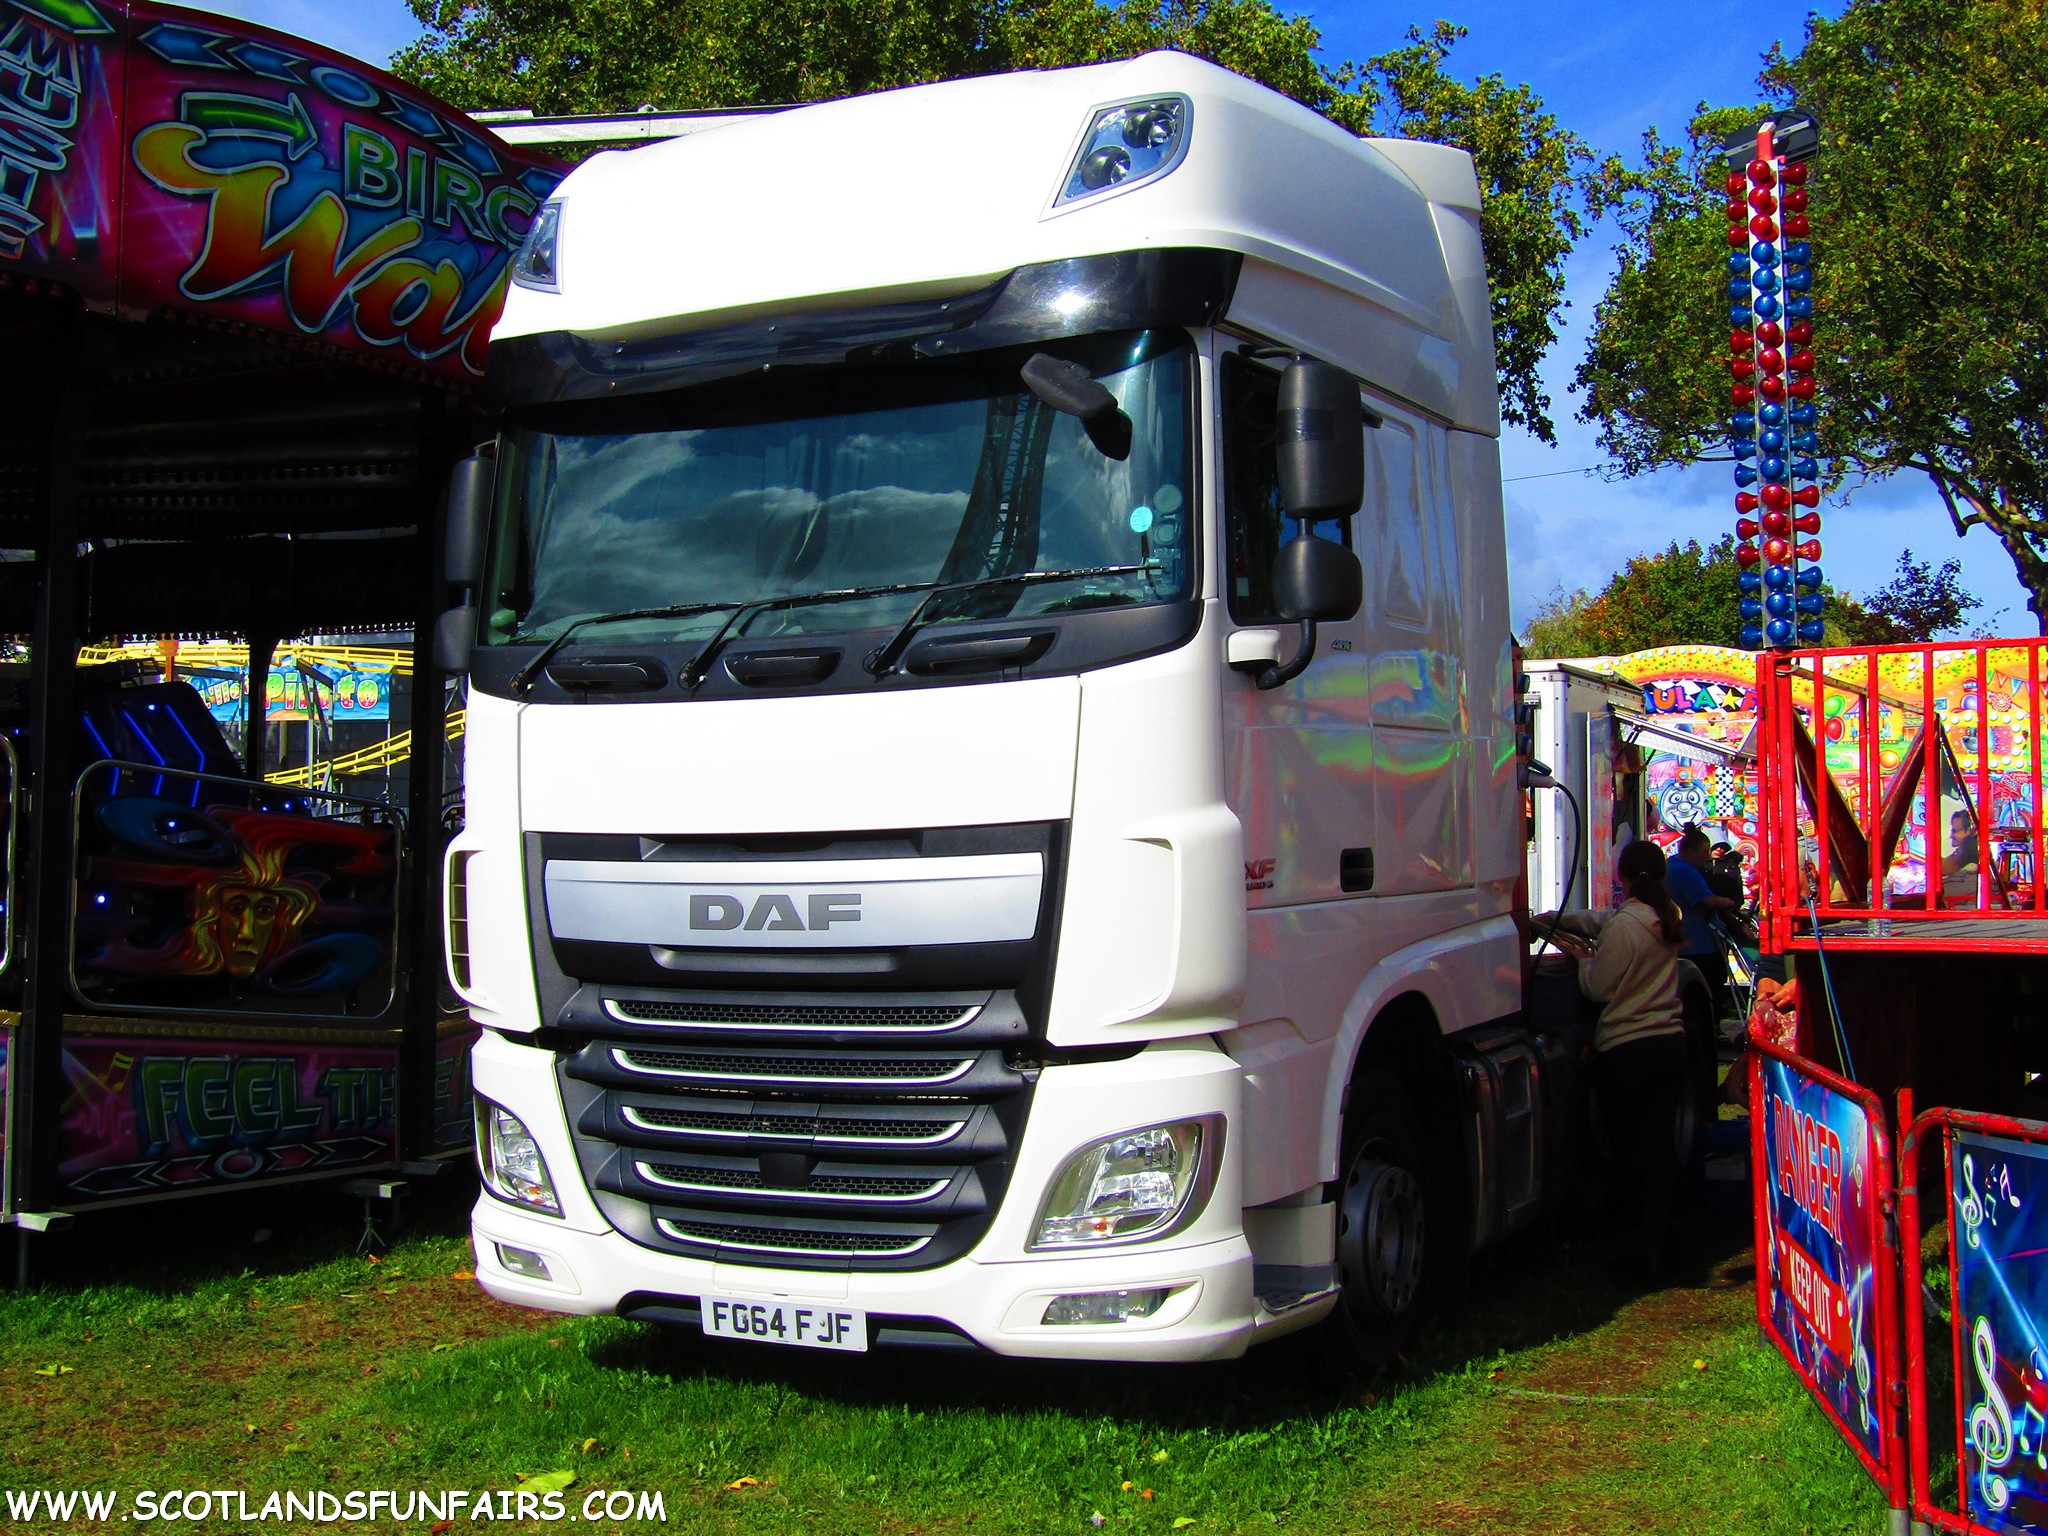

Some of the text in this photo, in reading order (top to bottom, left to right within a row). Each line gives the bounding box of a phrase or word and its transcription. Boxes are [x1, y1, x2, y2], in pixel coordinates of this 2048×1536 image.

[690, 893, 861, 931] DAF
[135, 1056, 323, 1153] FEEL
[1773, 1093, 1842, 1246] DANGER
[712, 1301, 852, 1344] FG64 FJF
[1789, 1245, 1832, 1341] KEEP OUT
